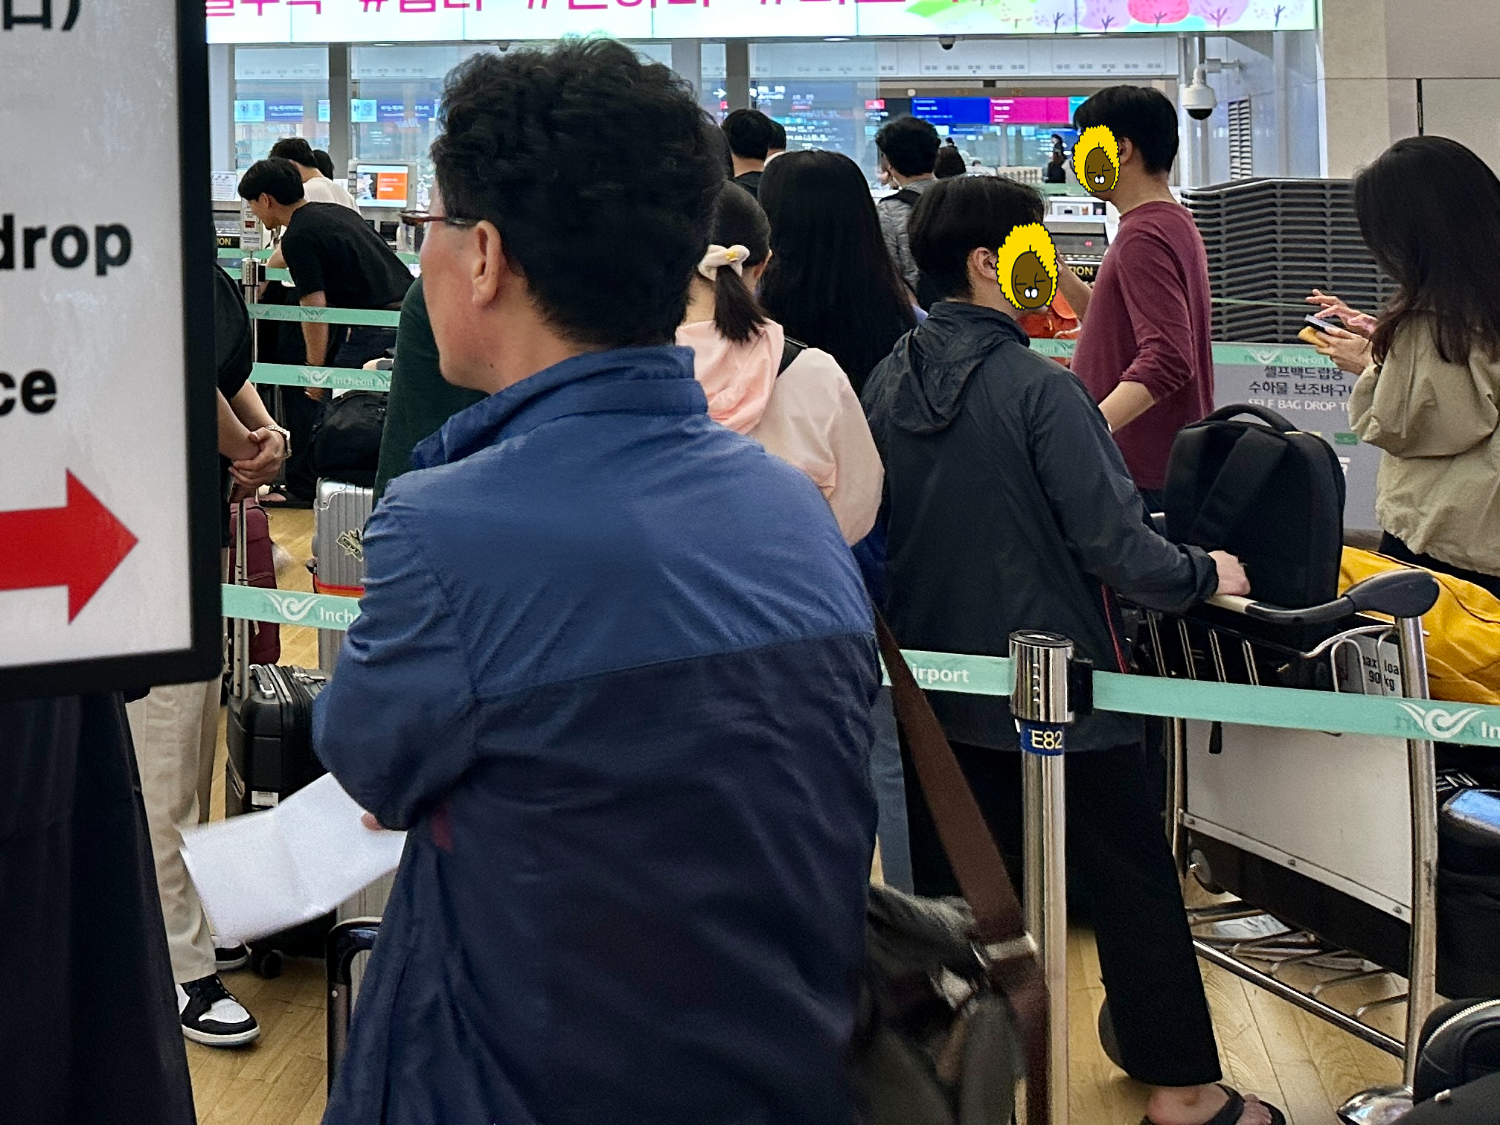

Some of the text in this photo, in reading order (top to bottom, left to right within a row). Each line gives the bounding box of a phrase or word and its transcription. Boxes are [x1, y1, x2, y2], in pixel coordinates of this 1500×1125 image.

[1304, 400, 1336, 411] DROP
[912, 663, 970, 684] irport
[1384, 659, 1400, 676] loa
[1384, 676, 1396, 692] kg
[1031, 729, 1063, 750] E82
